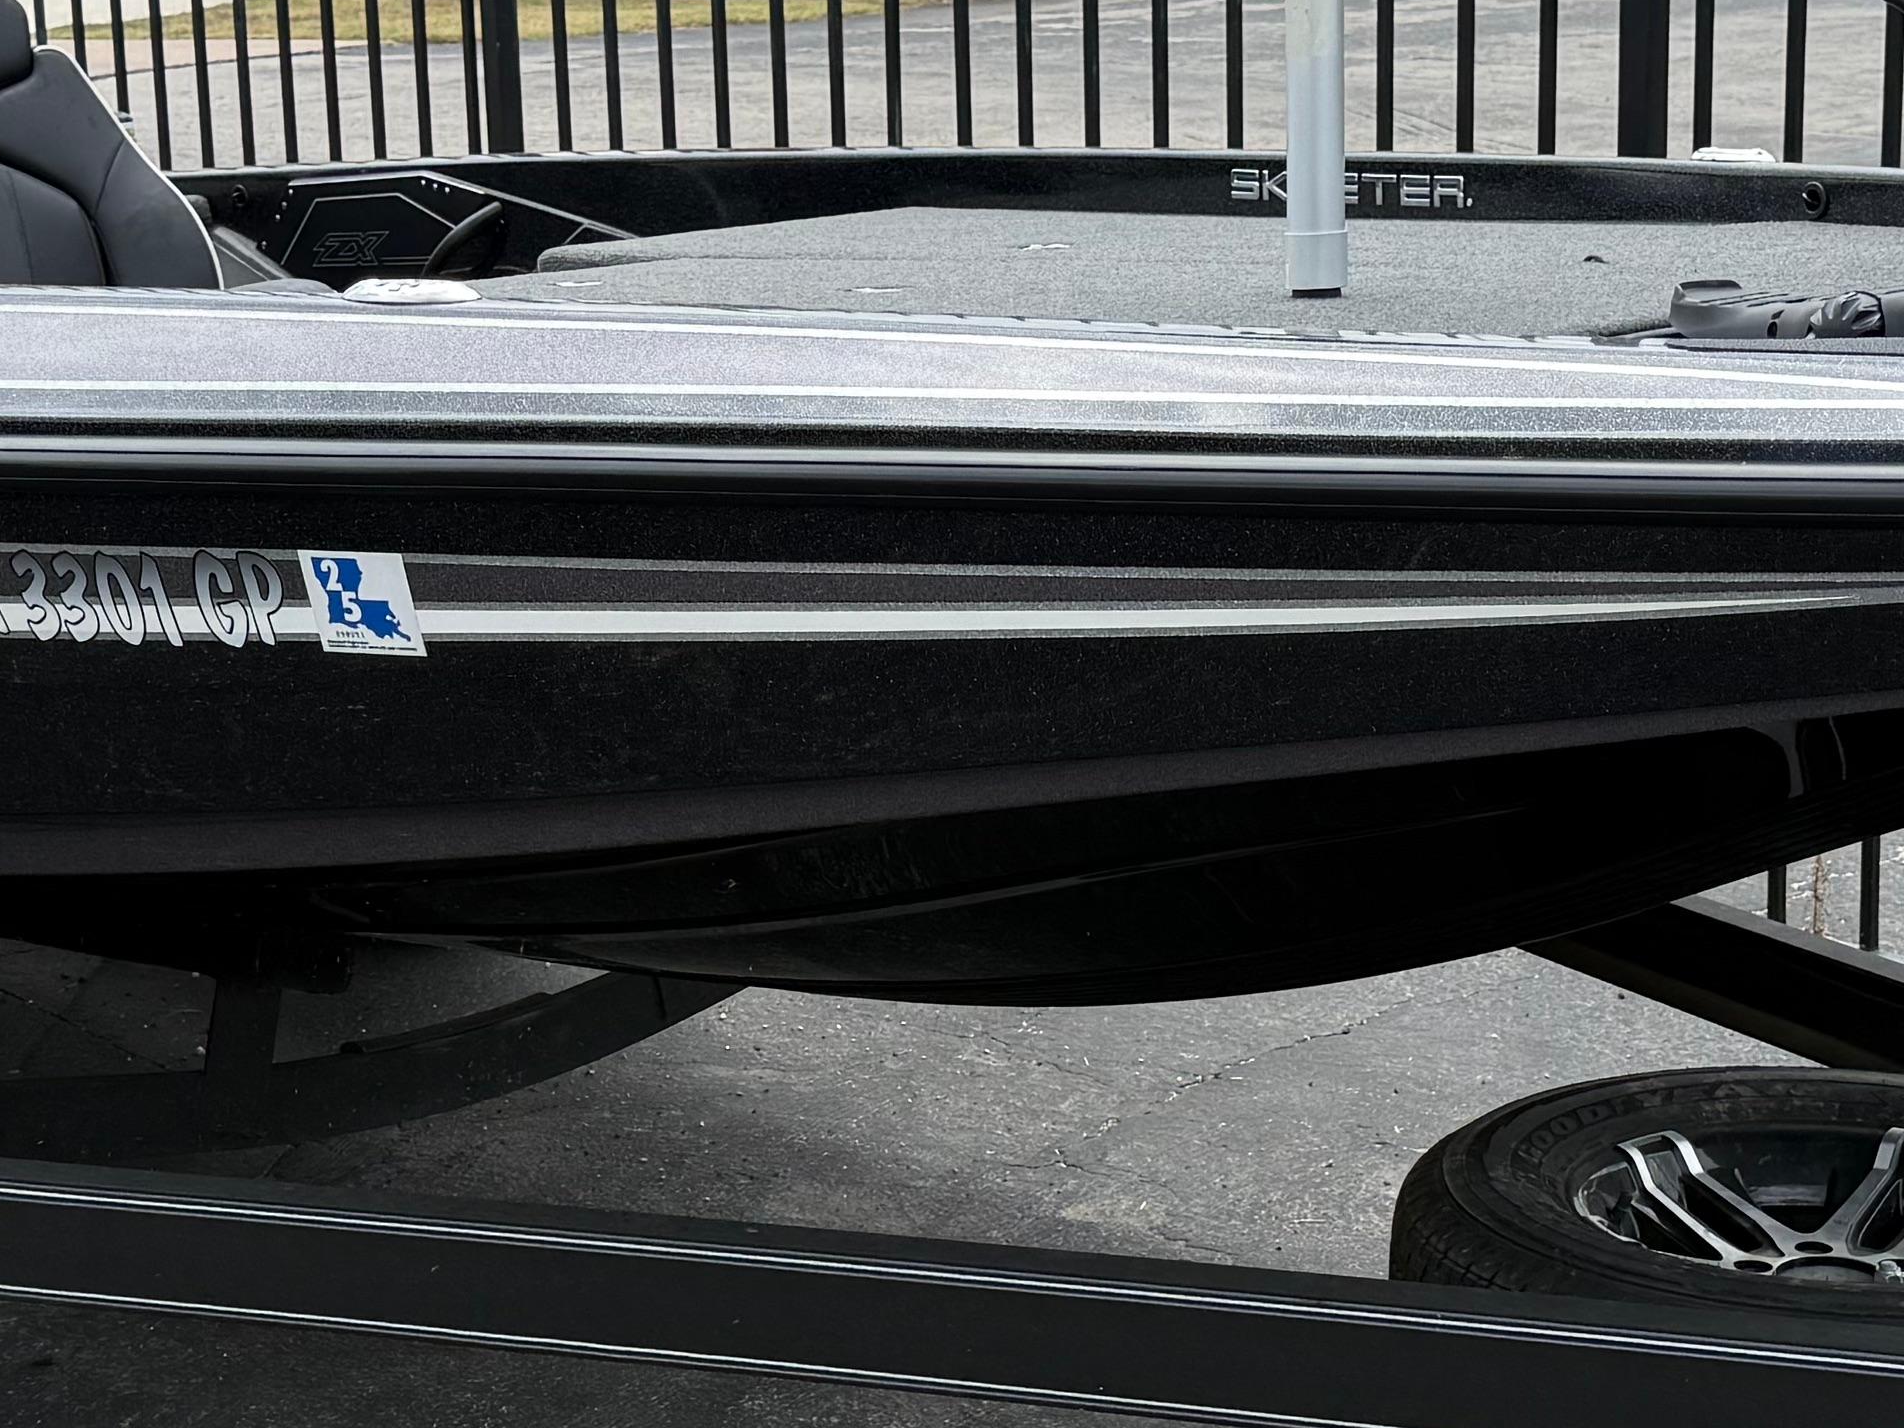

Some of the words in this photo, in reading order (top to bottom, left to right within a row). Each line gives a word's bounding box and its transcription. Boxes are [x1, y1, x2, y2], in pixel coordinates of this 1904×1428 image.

[1231, 168, 1464, 209] SKTER
[312, 230, 390, 267] ZX
[10, 548, 184, 647] 3301
[194, 548, 284, 648] GP
